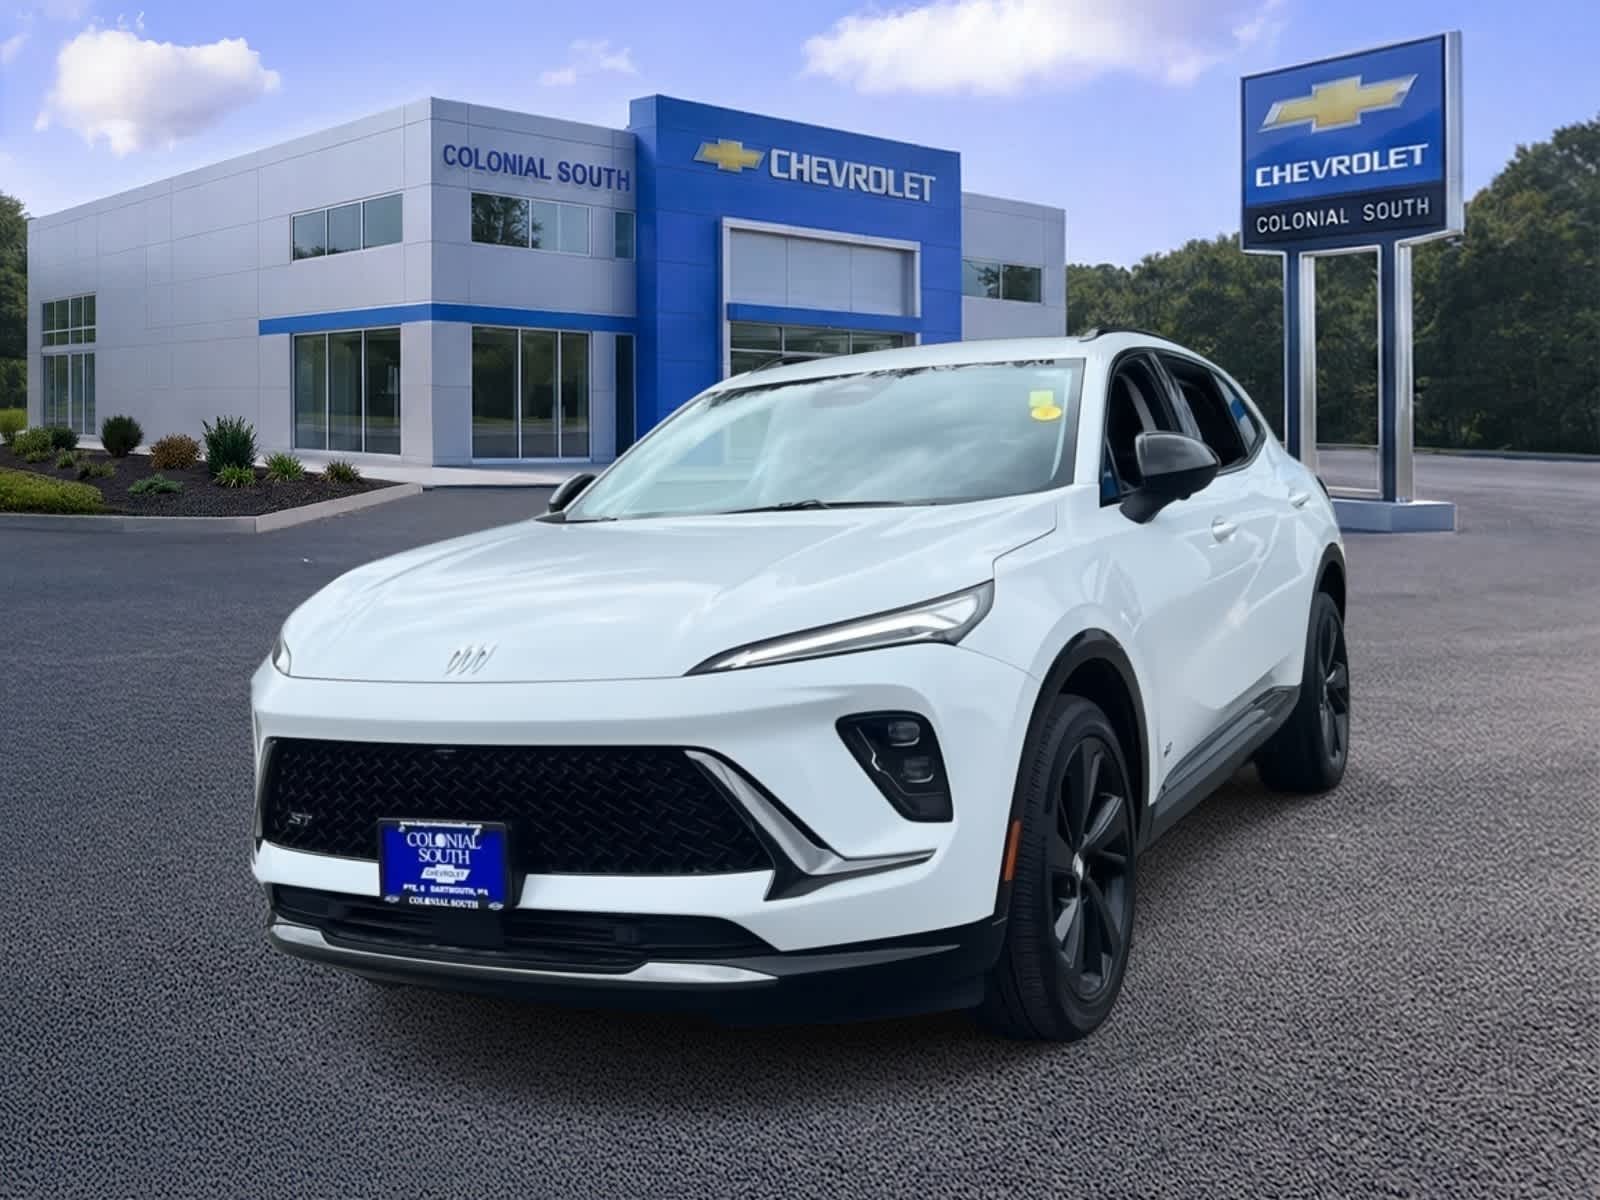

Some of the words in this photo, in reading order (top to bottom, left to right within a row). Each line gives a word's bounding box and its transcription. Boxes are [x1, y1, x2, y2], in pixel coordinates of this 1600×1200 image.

[443, 144, 552, 181] COLONIAL
[557, 161, 631, 192] SOUTH
[1255, 143, 1429, 188] CHEVROLET
[769, 148, 937, 202] CHEVROLET
[1256, 207, 1349, 234] COLONIAL
[1363, 197, 1430, 222] SOUTH
[288, 811, 313, 827] ST
[406, 831, 482, 849] COLONIAL
[418, 847, 471, 865] SOUTH
[424, 869, 465, 878] CHEVROLET
[408, 896, 450, 907] COLONIAL
[450, 899, 479, 909] SOUTH
